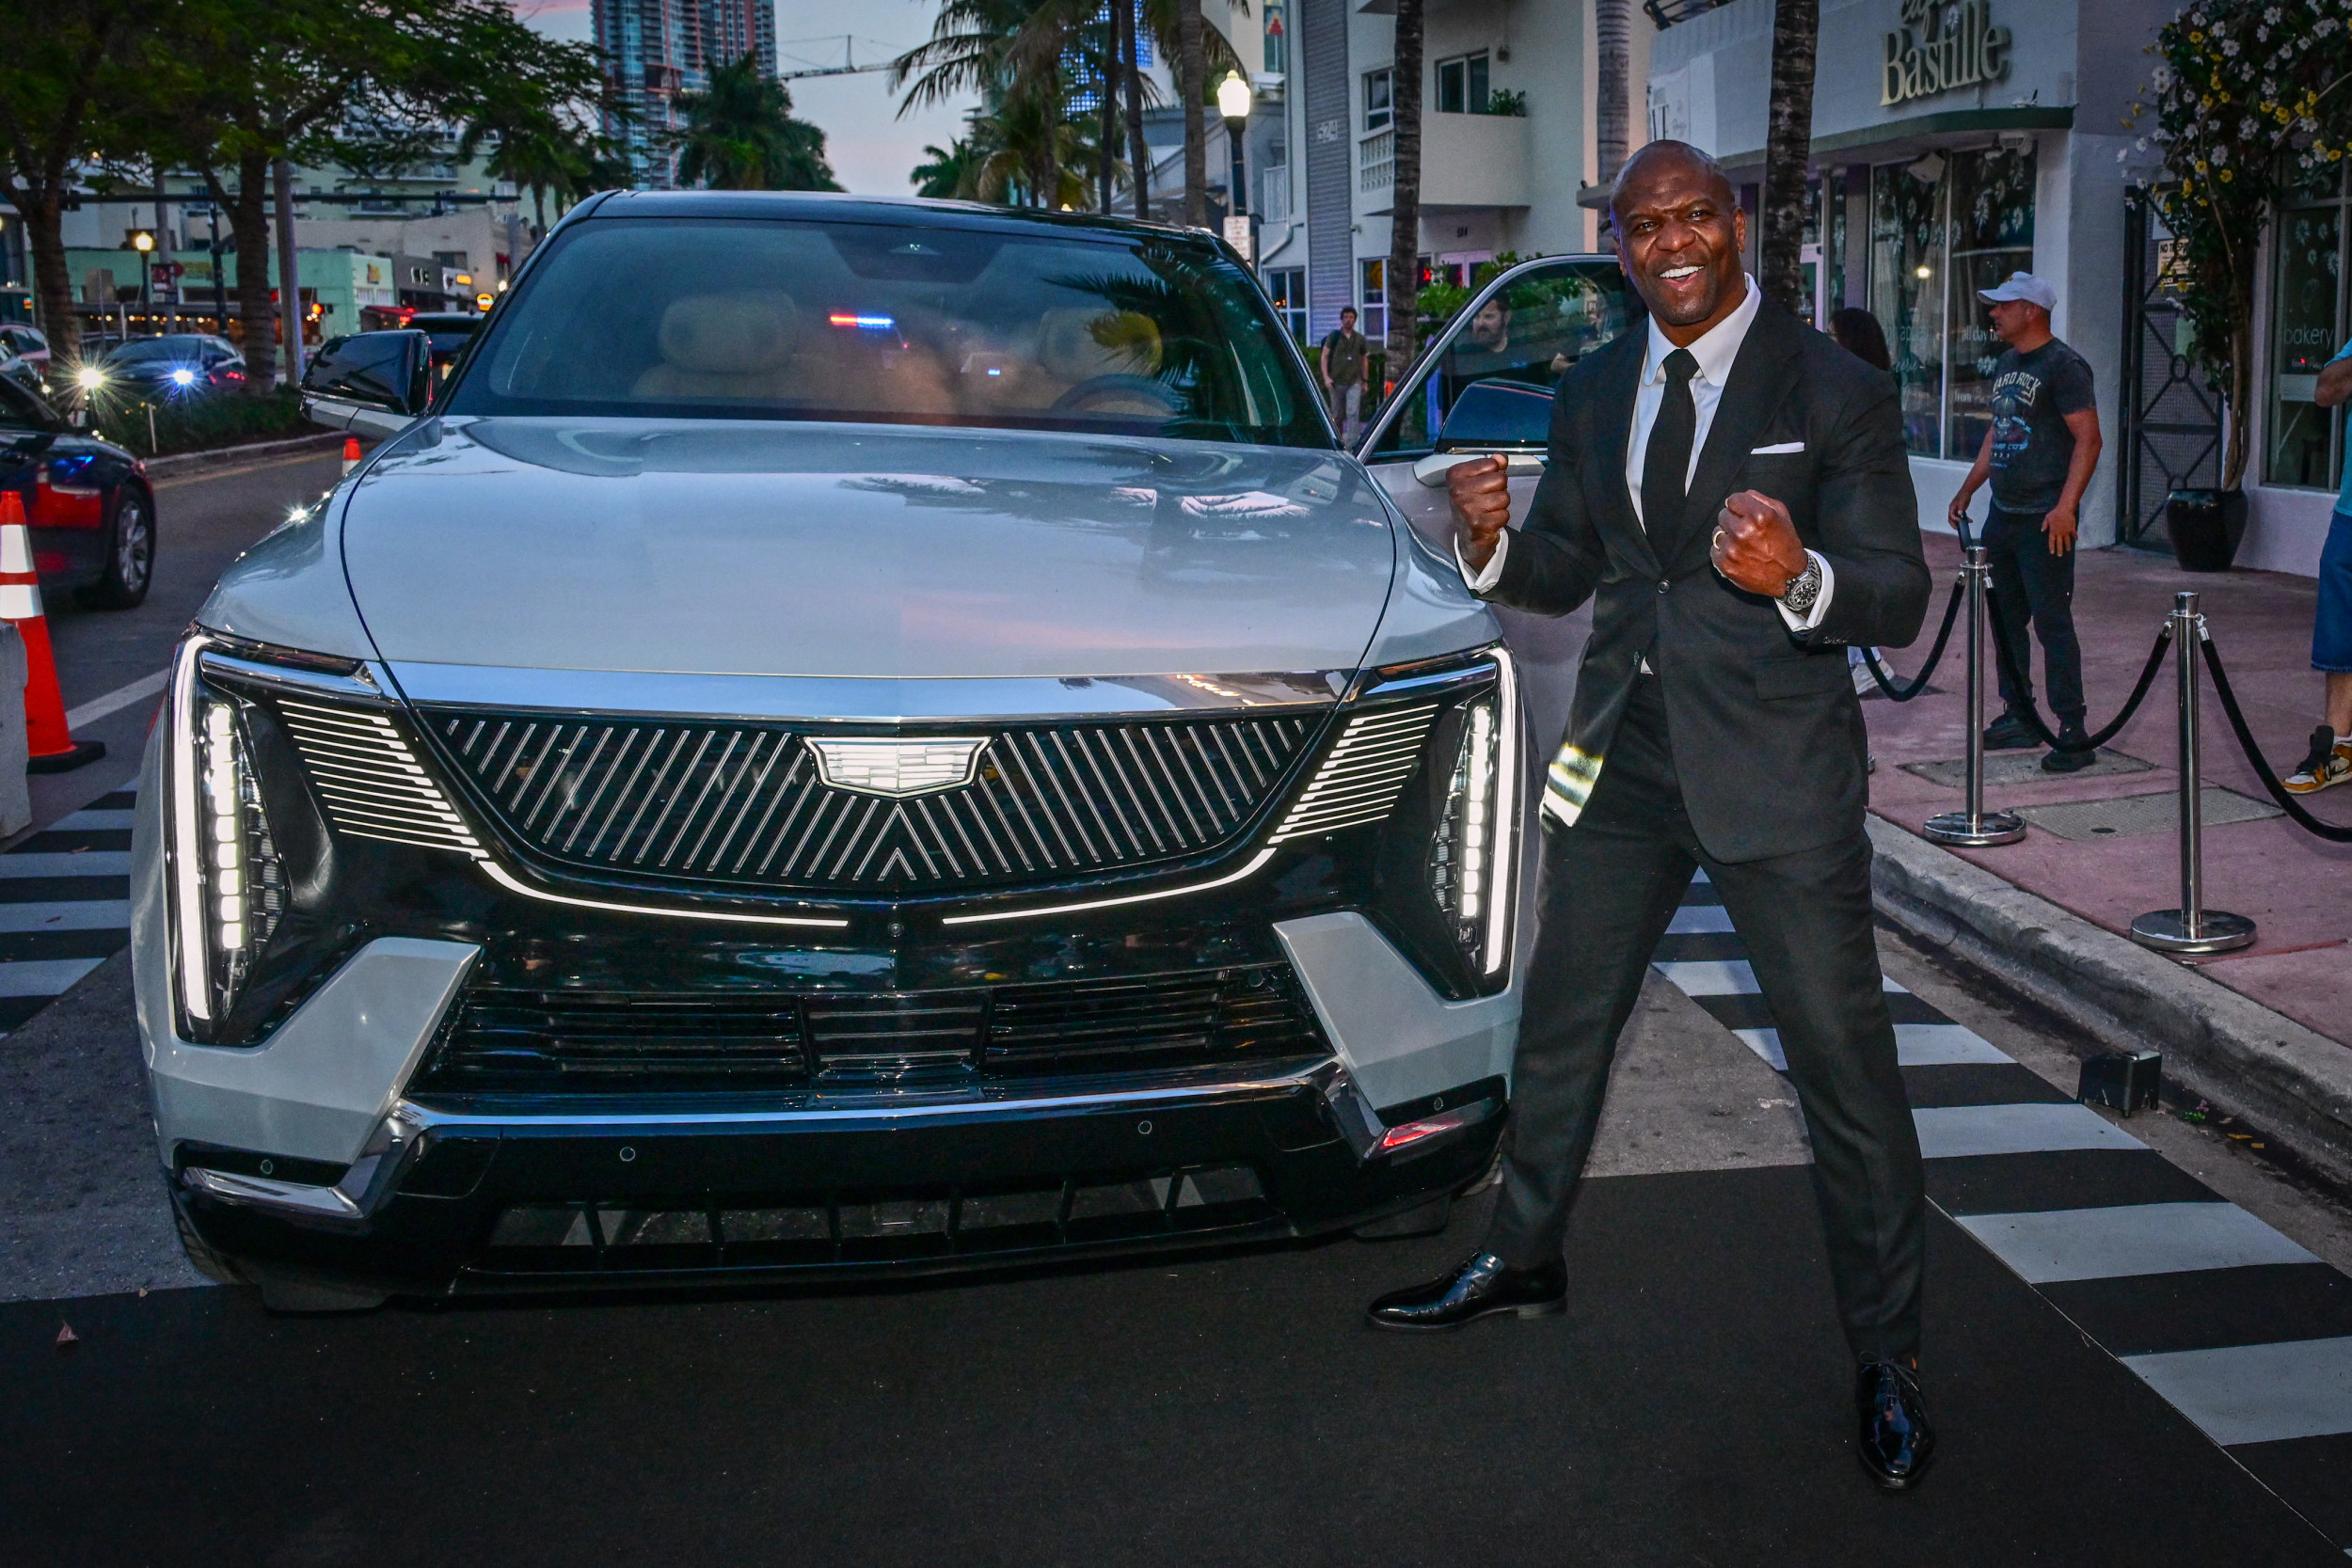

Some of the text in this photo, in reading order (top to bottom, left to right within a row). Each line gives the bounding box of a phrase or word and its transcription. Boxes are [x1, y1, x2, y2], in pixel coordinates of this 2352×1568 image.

[1880, 0, 2010, 106] Bastille
[1973, 325, 1987, 346] day
[2283, 322, 2333, 351] bakery
[2016, 372, 2042, 397] ROCK
